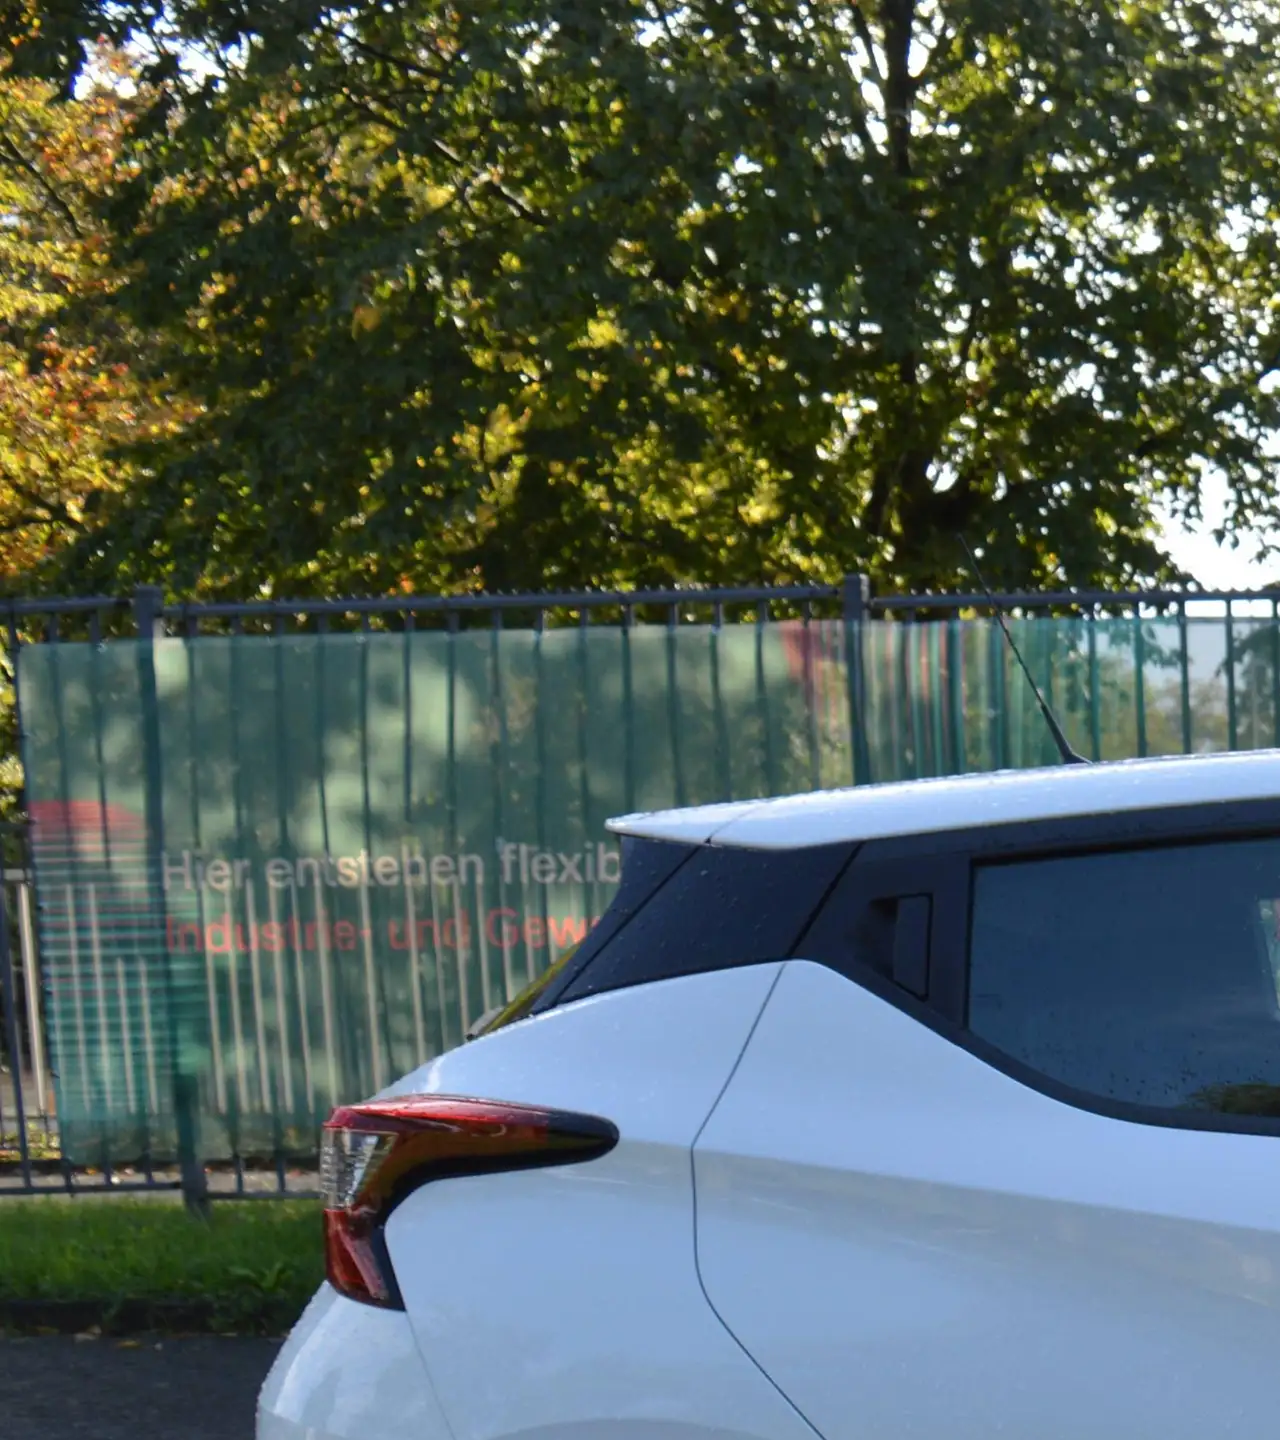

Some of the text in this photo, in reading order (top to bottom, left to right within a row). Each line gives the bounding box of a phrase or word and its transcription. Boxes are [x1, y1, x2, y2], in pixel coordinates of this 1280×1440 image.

[162, 850, 251, 890] Hier
[265, 842, 485, 888] entstehen
[165, 907, 600, 954] Industrie- und Gew
